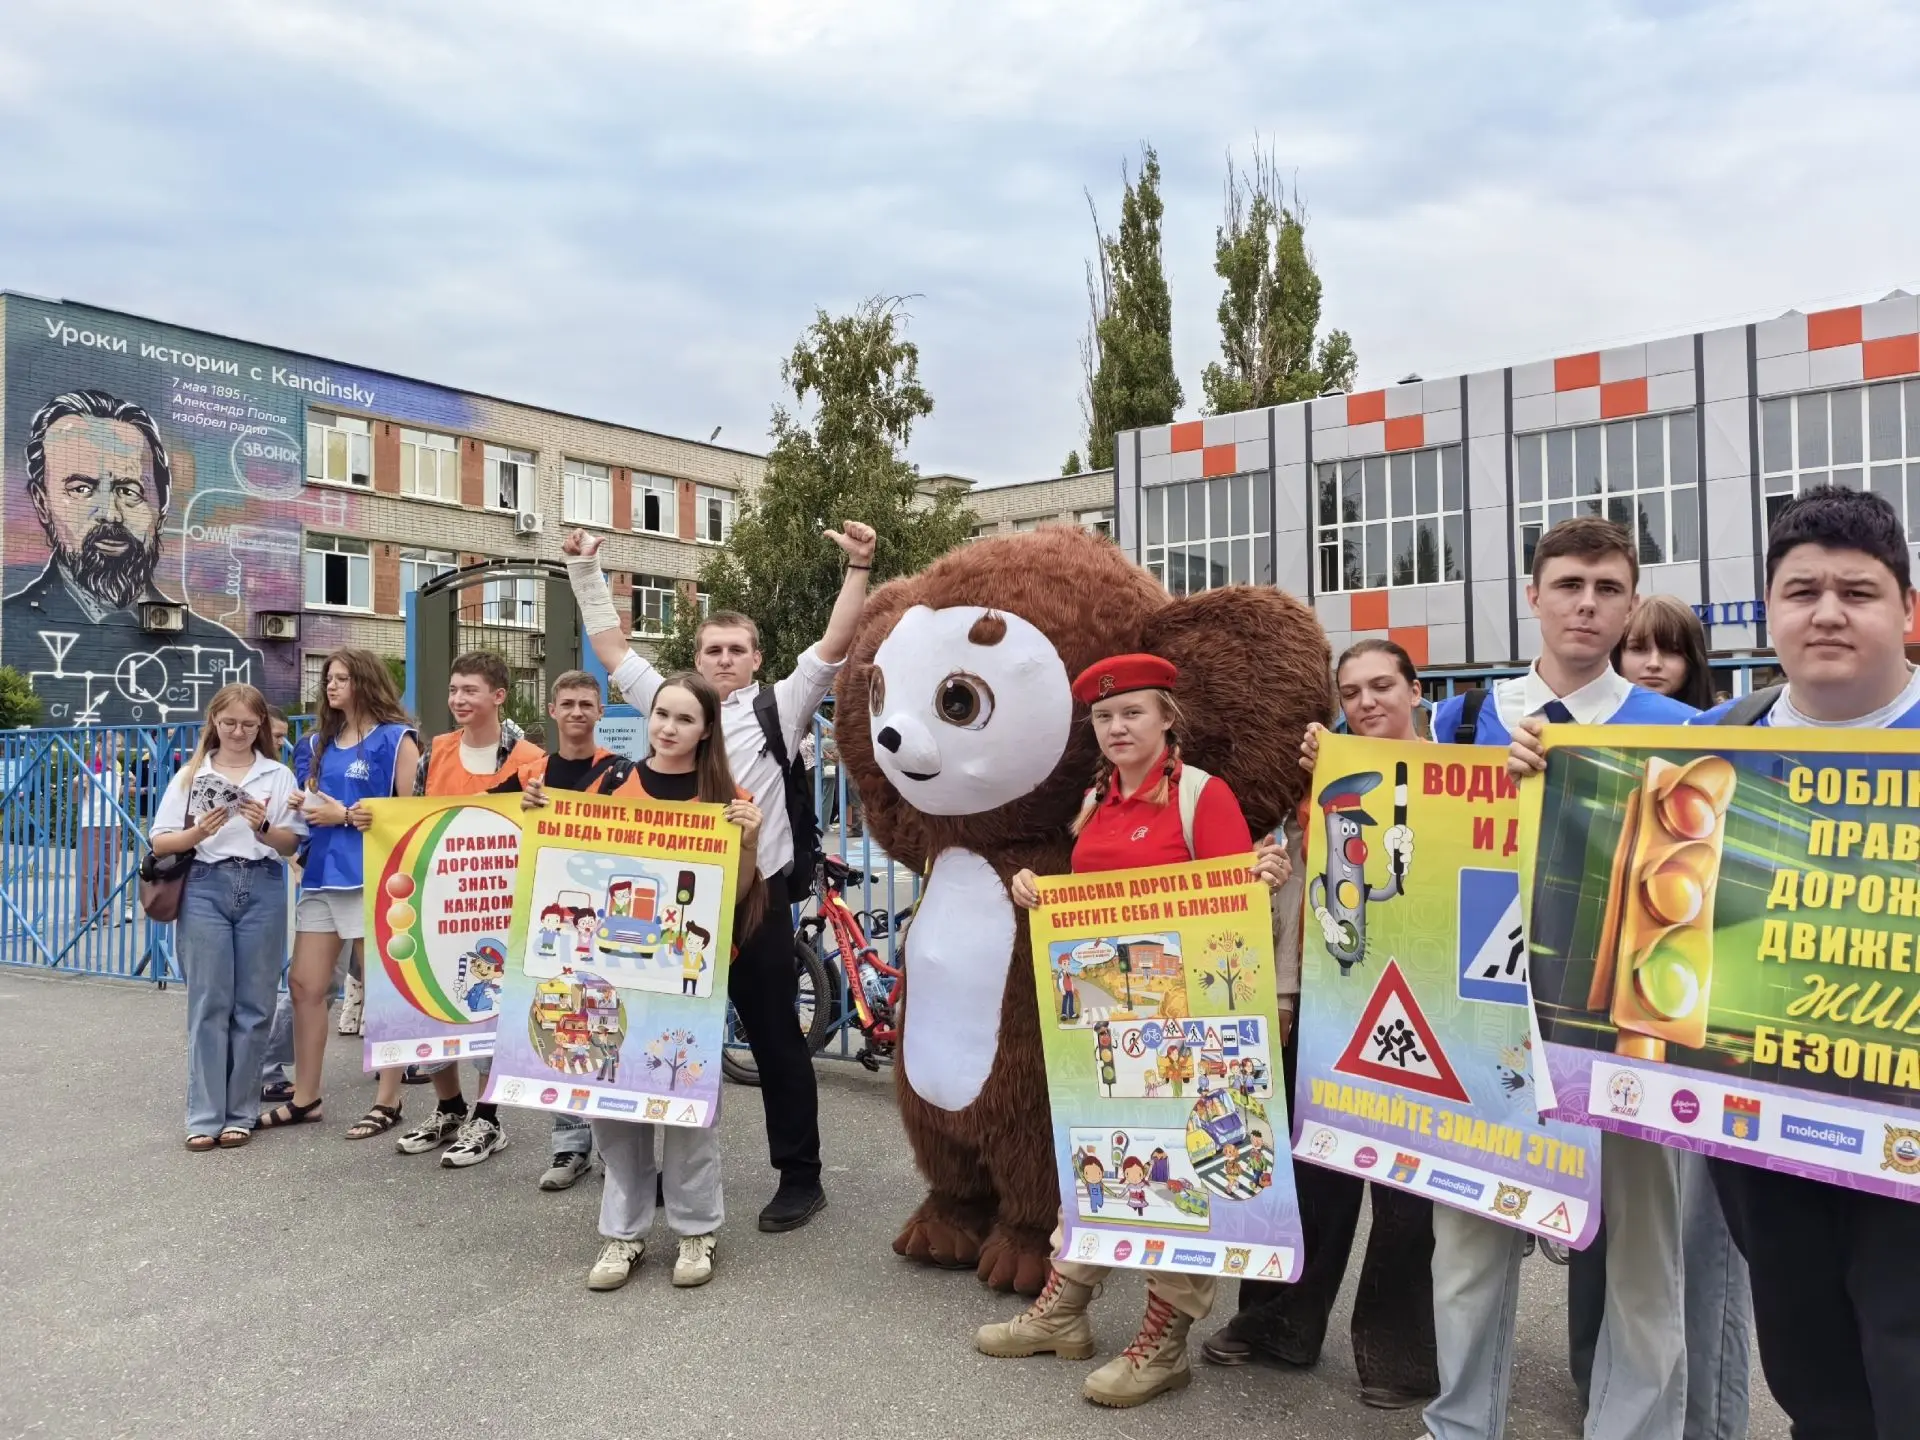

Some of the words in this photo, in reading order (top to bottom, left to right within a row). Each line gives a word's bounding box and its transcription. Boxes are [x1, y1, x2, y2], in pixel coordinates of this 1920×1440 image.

[43, 317, 127, 353] Уроки
[141, 343, 239, 377] истории
[250, 367, 262, 381] с
[271, 366, 375, 407] Kandinsky
[172, 377, 180, 388] 7
[183, 381, 208, 394] мая
[212, 385, 241, 400] 1895
[172, 394, 244, 417] Александр
[247, 407, 288, 424] Попов
[172, 411, 227, 429] изобрел
[229, 421, 268, 436] радио
[209, 658, 227, 674] SP
[50, 703, 69, 718] C1
[166, 687, 191, 702] C2
[554, 800, 571, 816] НЕ
[575, 801, 630, 823] ГОНИТЕ,
[634, 808, 716, 831] ВОДИТЕЛИ!
[445, 834, 518, 853] ПРАВИЛА
[537, 820, 560, 836] ВЫ
[564, 823, 602, 842] ВЕДЬ
[606, 827, 644, 845] ТОЖЕ
[647, 832, 728, 854] РОДИТЕЛИ!
[1472, 816, 1494, 850] И
[1807, 819, 1920, 862] ПРАВ
[458, 875, 508, 893] ЗНАТЬ
[1129, 874, 1188, 899] ДОРОГА
[1191, 873, 1202, 890] В
[1206, 866, 1261, 888] ШКОЛ
[1765, 868, 1920, 918] ДОРОЖ
[1051, 906, 1118, 929] БЕРЕГИТЕ
[1122, 902, 1160, 923] СЕБЯ
[1163, 900, 1173, 918] И
[1178, 893, 1249, 917] БЛИЗКИХ
[1757, 919, 1920, 973] ДВИЖЕ
[1310, 1078, 1433, 1136] УВАЖАЙТЕ
[1437, 1110, 1523, 1161] ЗНАКИ
[1527, 1134, 1585, 1179] ЭТИ!
